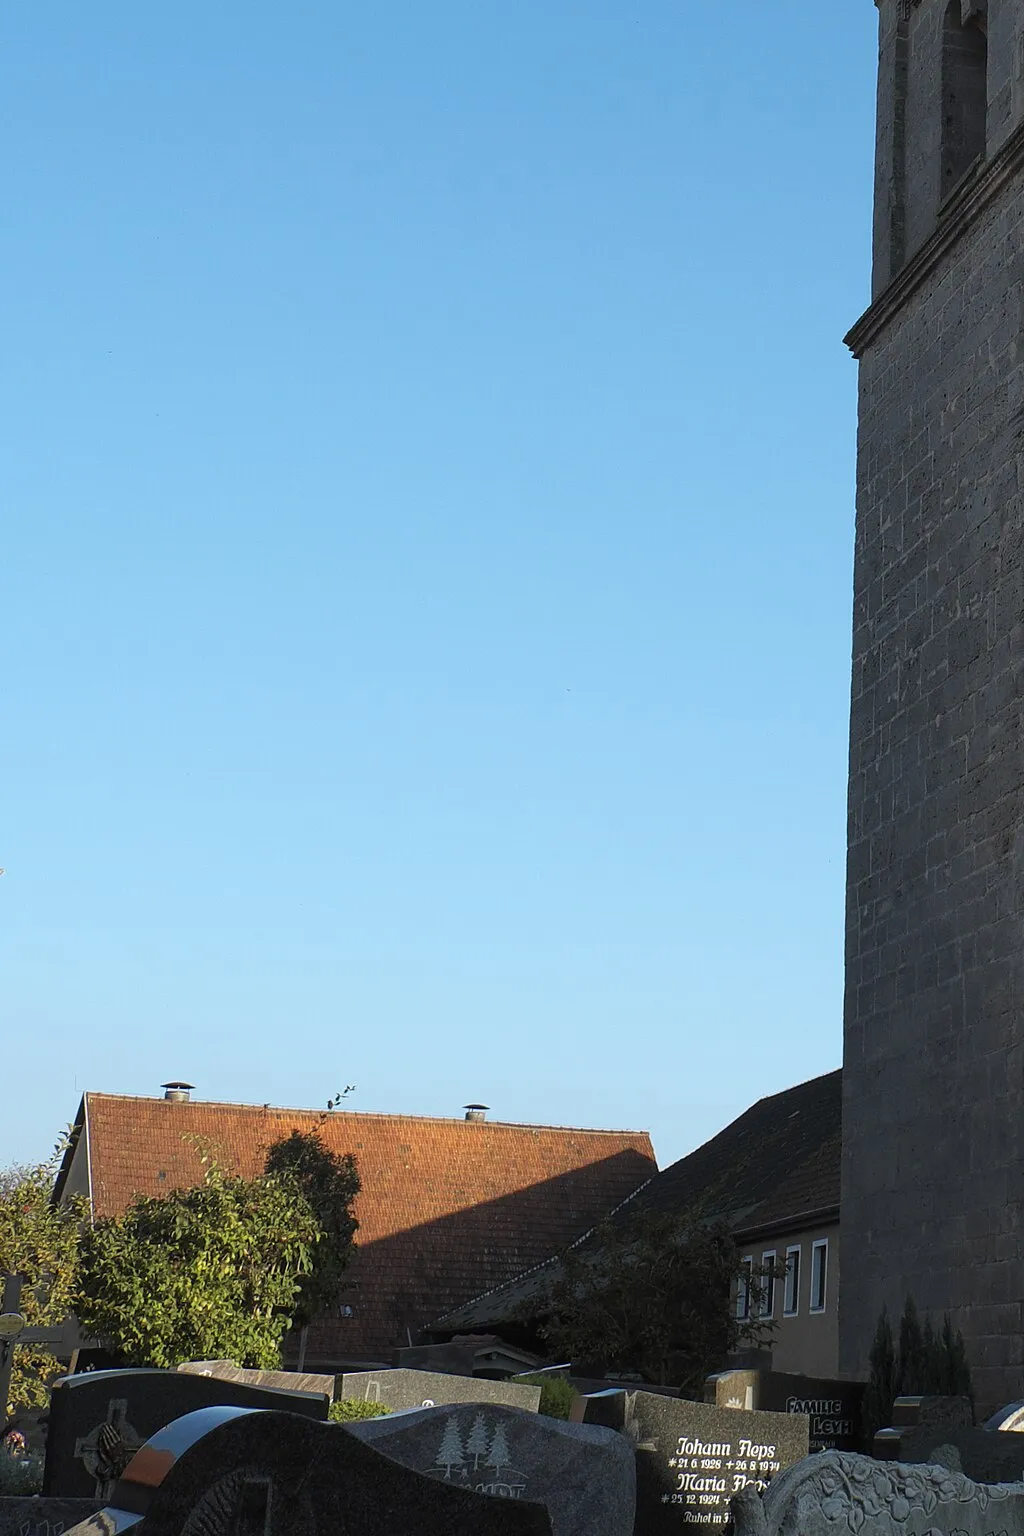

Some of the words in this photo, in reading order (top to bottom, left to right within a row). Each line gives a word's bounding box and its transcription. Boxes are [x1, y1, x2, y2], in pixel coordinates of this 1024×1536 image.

[676, 1437, 731, 1456] Johann
[737, 1439, 776, 1461] Fleps
[700, 1459, 722, 1469] 1928
[676, 1473, 726, 1492] Maria
[699, 1495, 720, 1505] 1924
[712, 1512, 722, 1523] in
